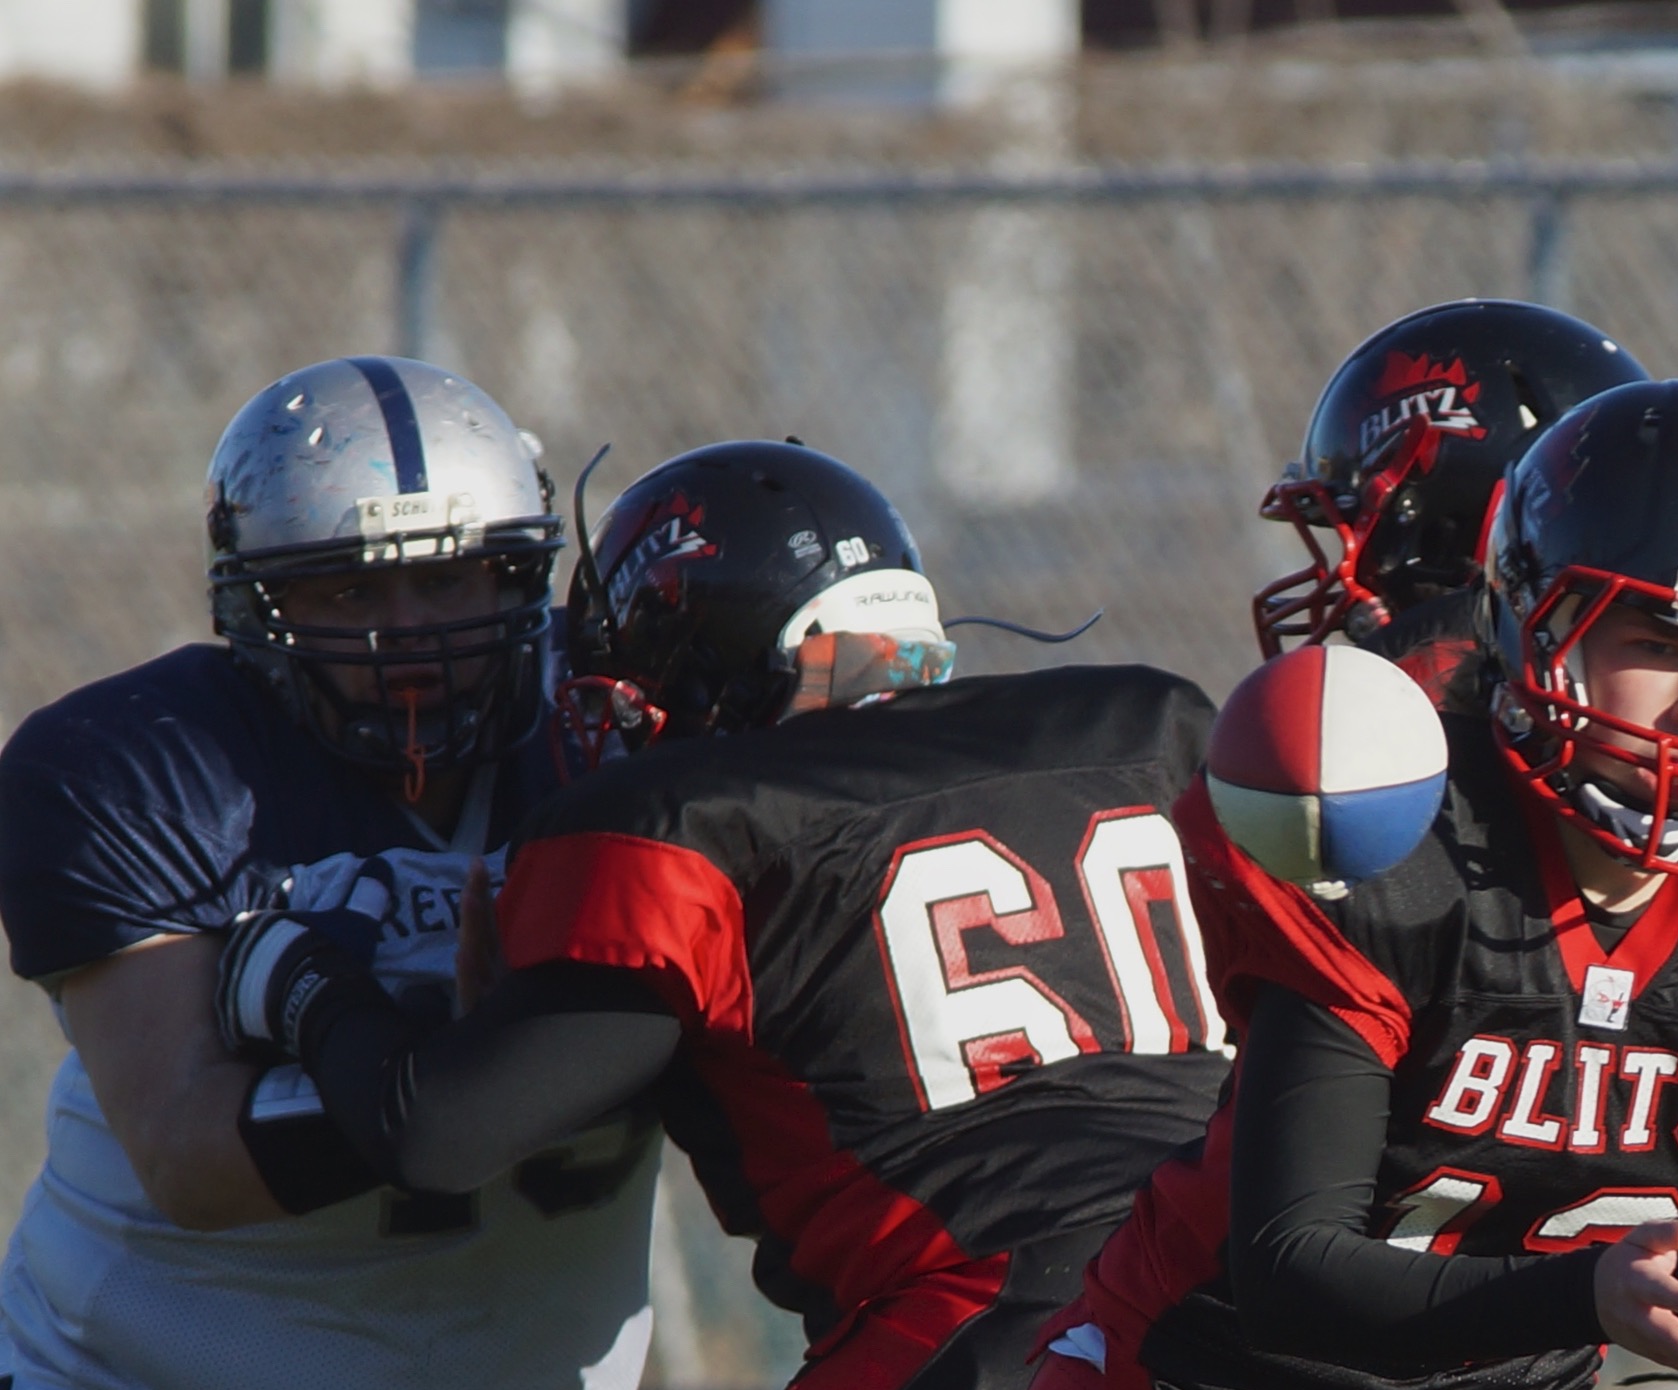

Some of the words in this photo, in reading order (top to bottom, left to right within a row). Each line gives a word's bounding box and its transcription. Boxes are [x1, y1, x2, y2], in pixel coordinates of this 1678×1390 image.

[1360, 386, 1473, 456] BLITZ
[836, 536, 870, 567] 60
[873, 804, 1236, 1112] 60
